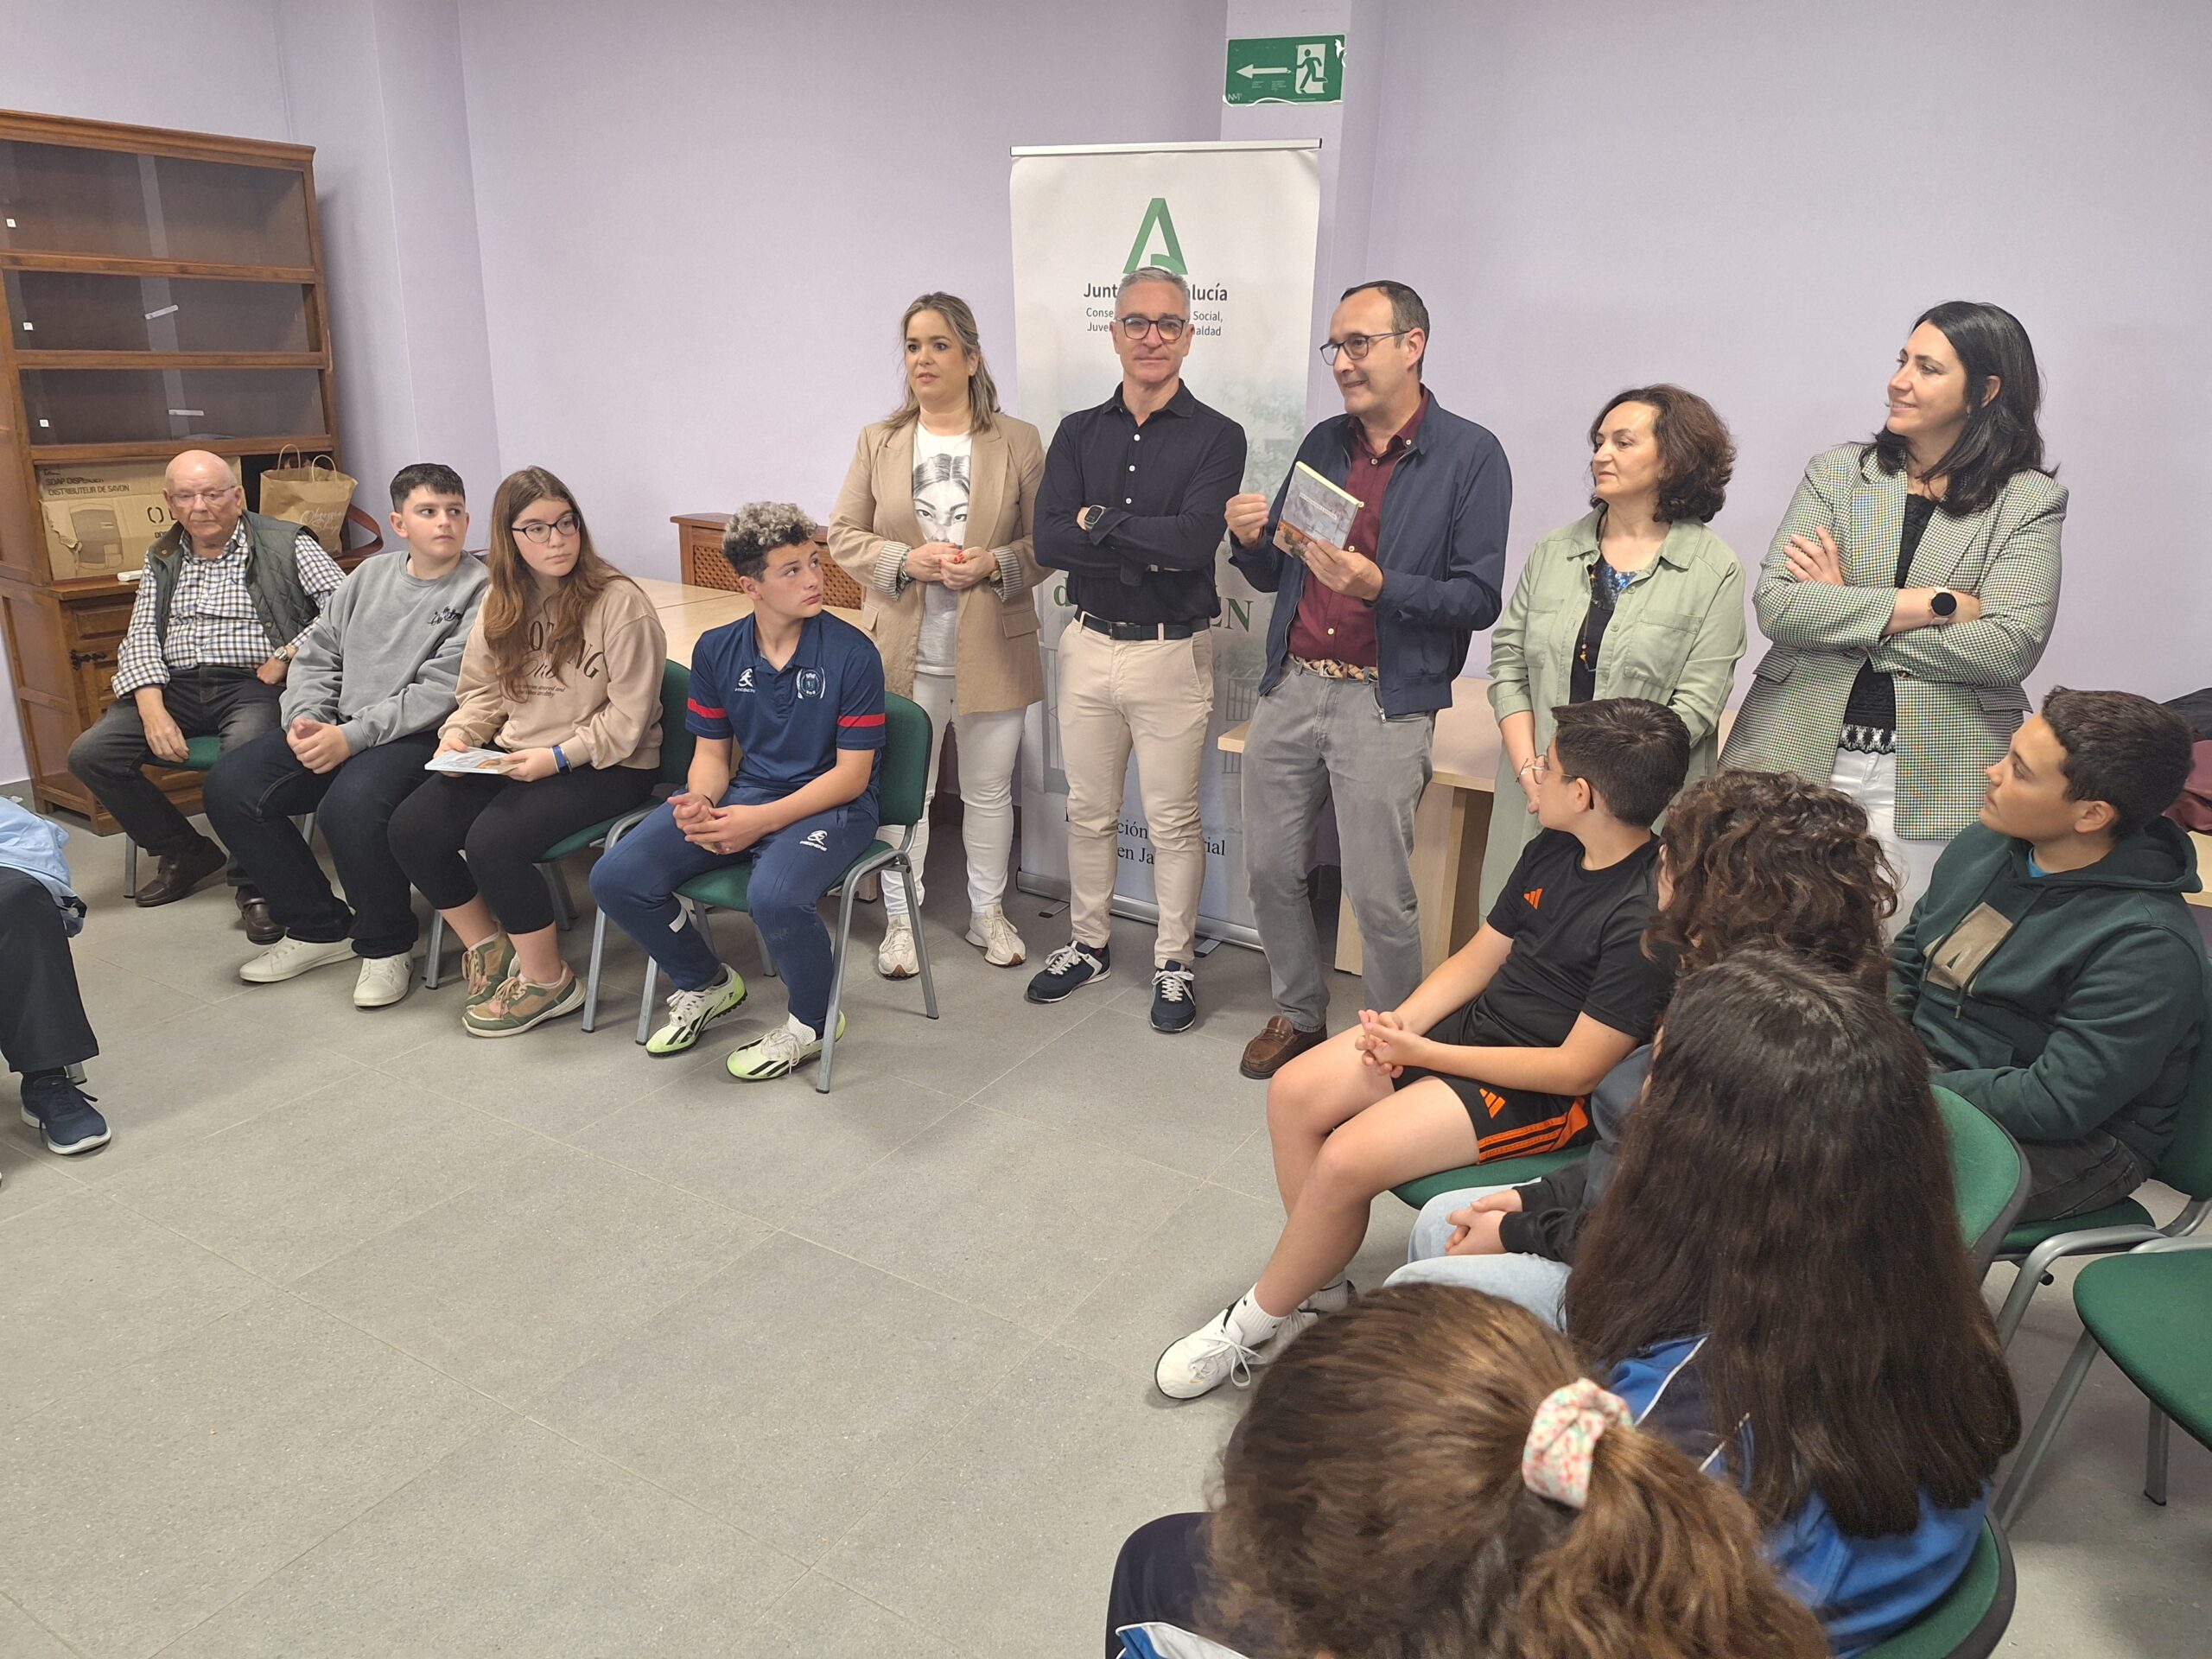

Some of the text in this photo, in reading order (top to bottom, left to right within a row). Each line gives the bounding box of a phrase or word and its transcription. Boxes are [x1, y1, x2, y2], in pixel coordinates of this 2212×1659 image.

[1084, 283, 1118, 298] Junt
[1193, 311, 1224, 323] Social,
[108, 483, 130, 493] SAVON
[1139, 847, 1154, 865] Ja
